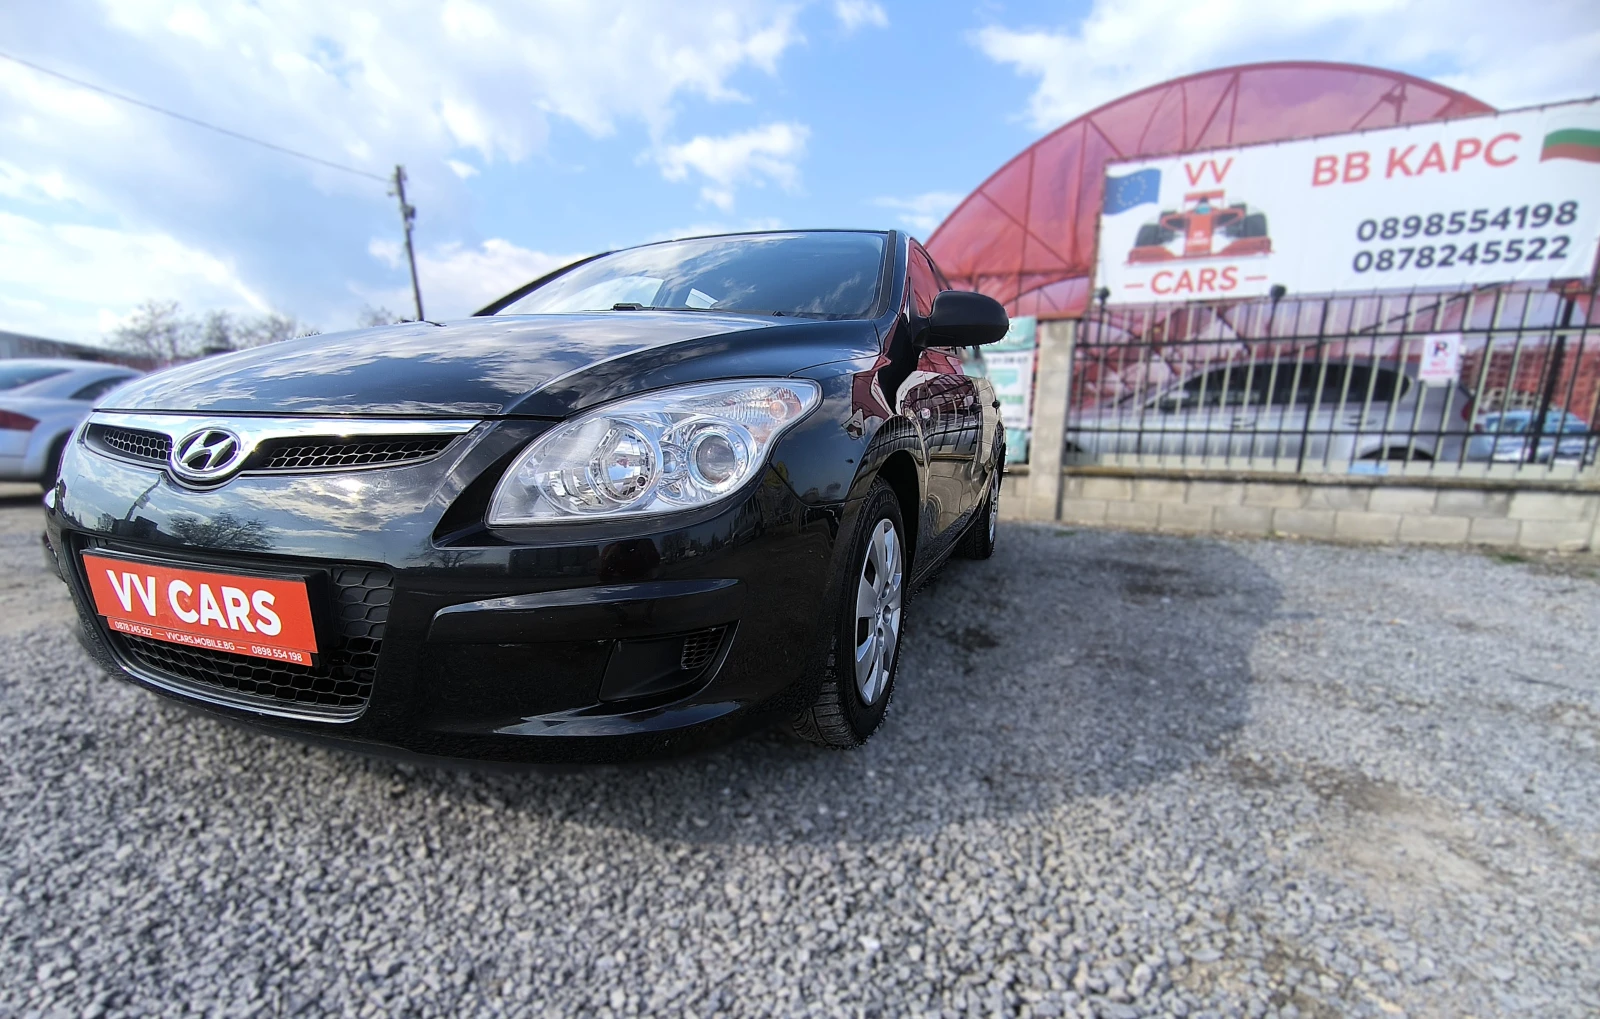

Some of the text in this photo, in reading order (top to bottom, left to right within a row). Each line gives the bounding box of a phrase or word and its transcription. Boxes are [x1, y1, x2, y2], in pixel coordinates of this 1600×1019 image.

[1184, 157, 1234, 187] VV
[1311, 132, 1522, 187] ВВ КАРС
[1356, 200, 1579, 242] 0898554198
[1352, 235, 1571, 273] 0878245522
[1150, 266, 1239, 295] CARS
[106, 569, 282, 636] VV CARS
[114, 621, 303, 662] 0878 245 522 VVCARS.MOBILE.BG 0898 554 198
